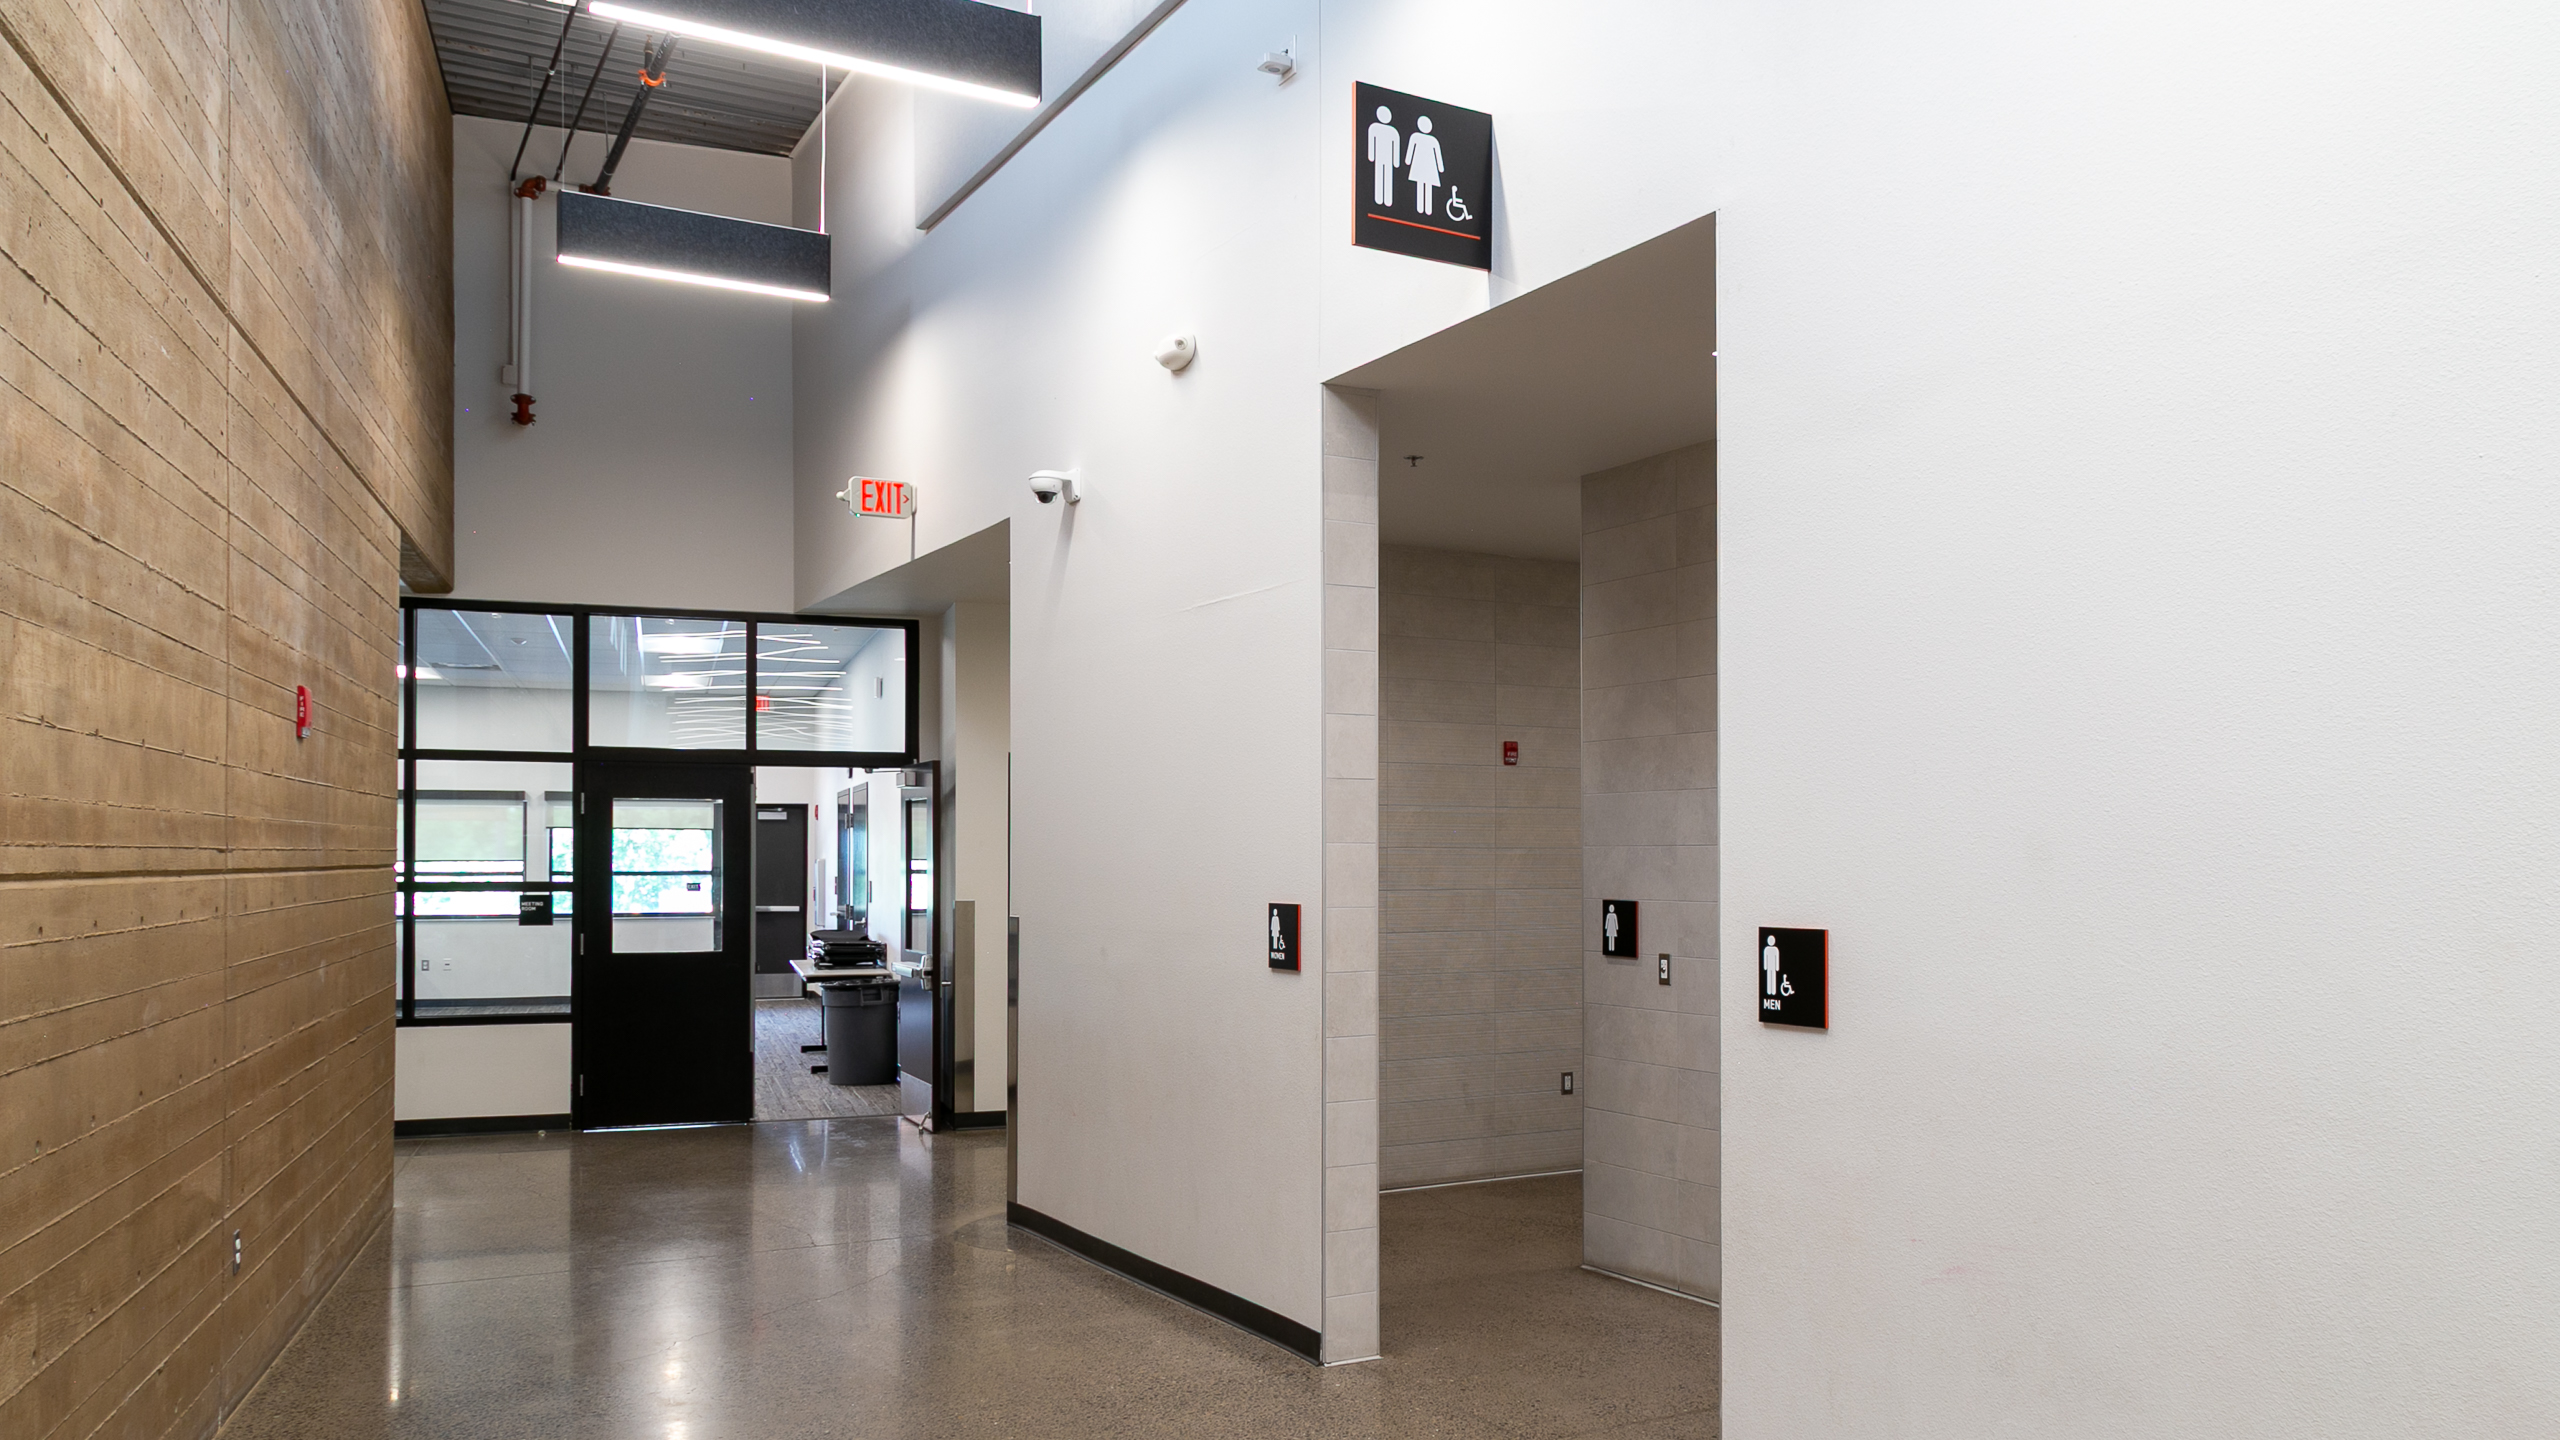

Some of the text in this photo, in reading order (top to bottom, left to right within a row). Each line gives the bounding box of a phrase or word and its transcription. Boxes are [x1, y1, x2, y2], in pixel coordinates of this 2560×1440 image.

[861, 479, 904, 515] EXIT
[1270, 951, 1285, 960] WOMEN
[1763, 998, 1781, 1011] MEN
